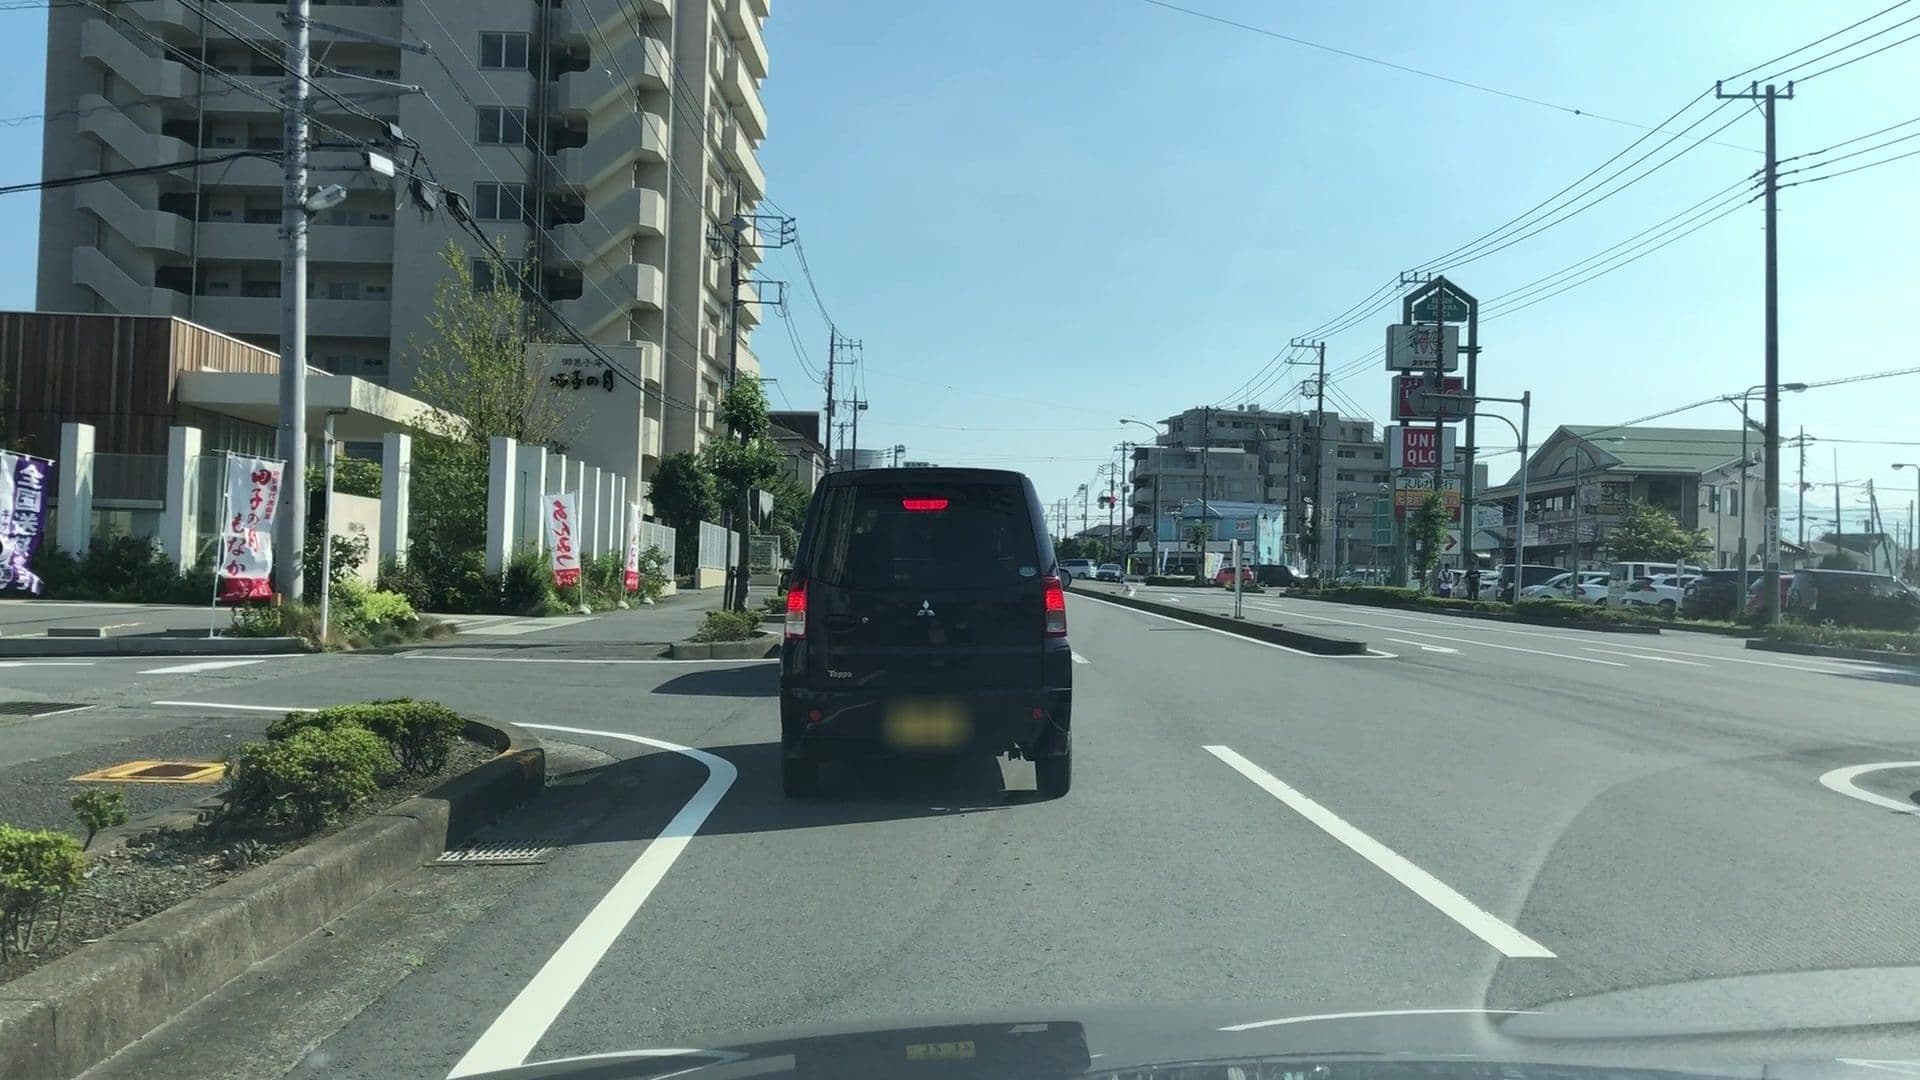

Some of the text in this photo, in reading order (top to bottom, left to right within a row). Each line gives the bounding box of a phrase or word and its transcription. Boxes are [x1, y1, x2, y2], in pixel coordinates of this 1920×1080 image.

[247, 468, 272, 553] 田子の月
[1402, 478, 1454, 490] スルガ行
[226, 511, 246, 577] もなか
